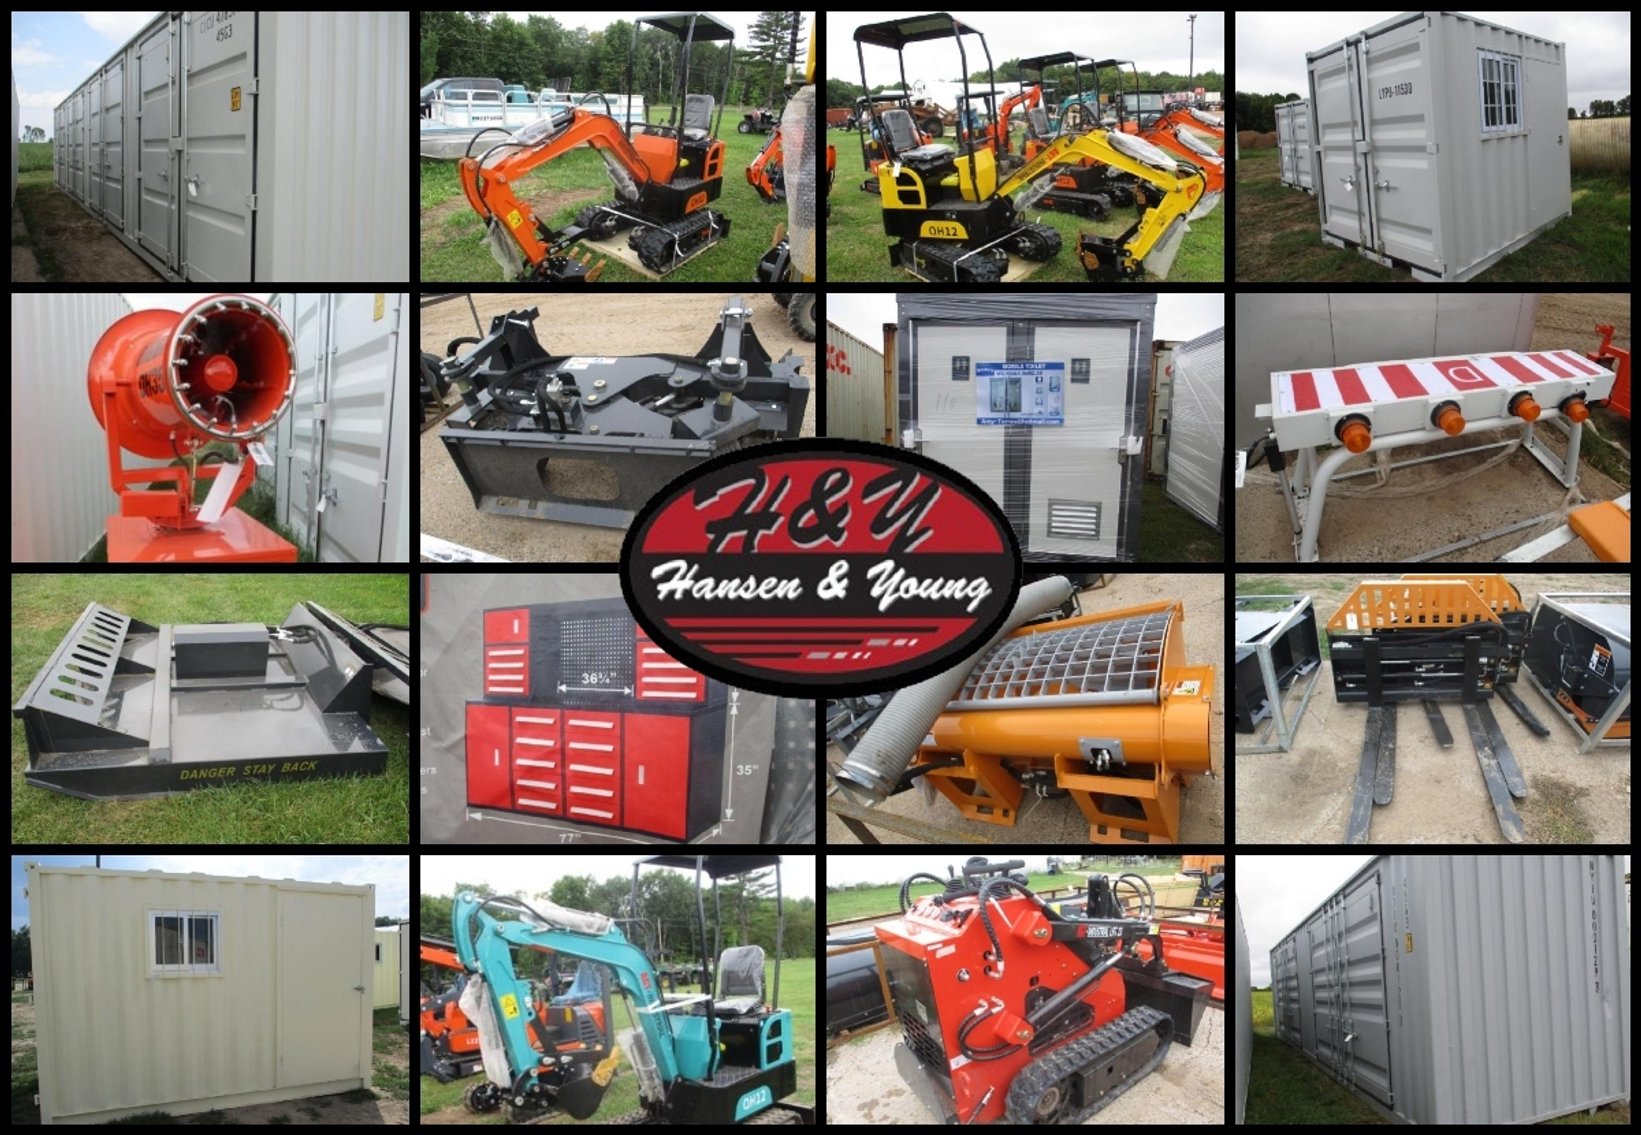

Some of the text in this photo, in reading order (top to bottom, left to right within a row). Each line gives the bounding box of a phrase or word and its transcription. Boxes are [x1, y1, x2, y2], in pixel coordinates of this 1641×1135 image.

[180, 760, 319, 780] DANGER STAY BACK
